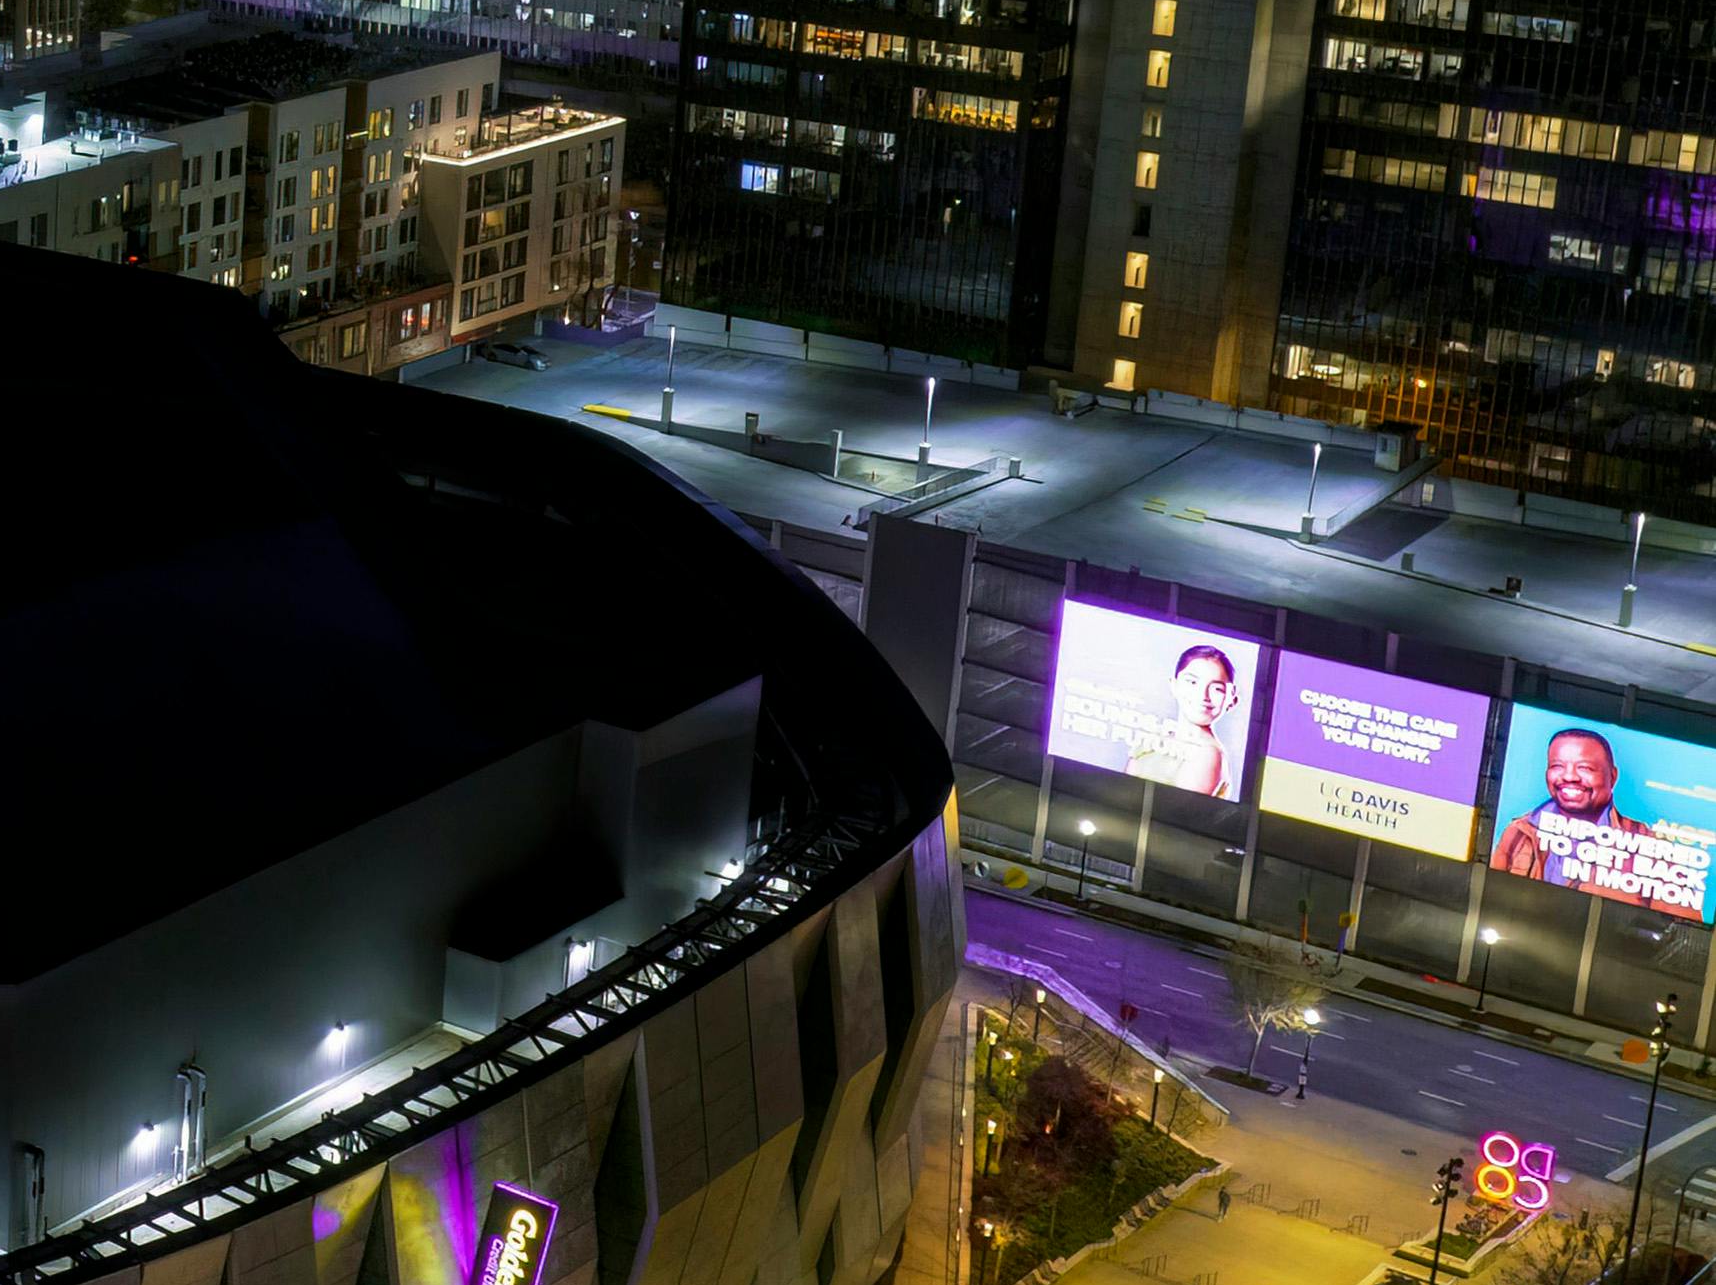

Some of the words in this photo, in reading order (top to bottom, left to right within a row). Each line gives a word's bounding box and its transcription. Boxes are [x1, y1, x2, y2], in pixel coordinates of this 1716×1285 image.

[1300, 689, 1372, 718] CHOOSE
[1373, 706, 1408, 727] THE
[1410, 716, 1458, 739] CARE
[1312, 707, 1357, 729] THAT
[1358, 720, 1441, 750] CHANGES
[1322, 726, 1370, 749] YOUR
[1326, 802, 1398, 829] HEALTH
[1351, 790, 1410, 816] DAVIS
[1537, 830, 1572, 856] TO
[1576, 843, 1630, 869] GET
[1632, 855, 1708, 891] BACK
[1540, 811, 1711, 869] EMPOWERED
[1562, 857, 1591, 883] IN
[1595, 866, 1705, 910] MOTION
[486, 1239, 505, 1275] Credit
